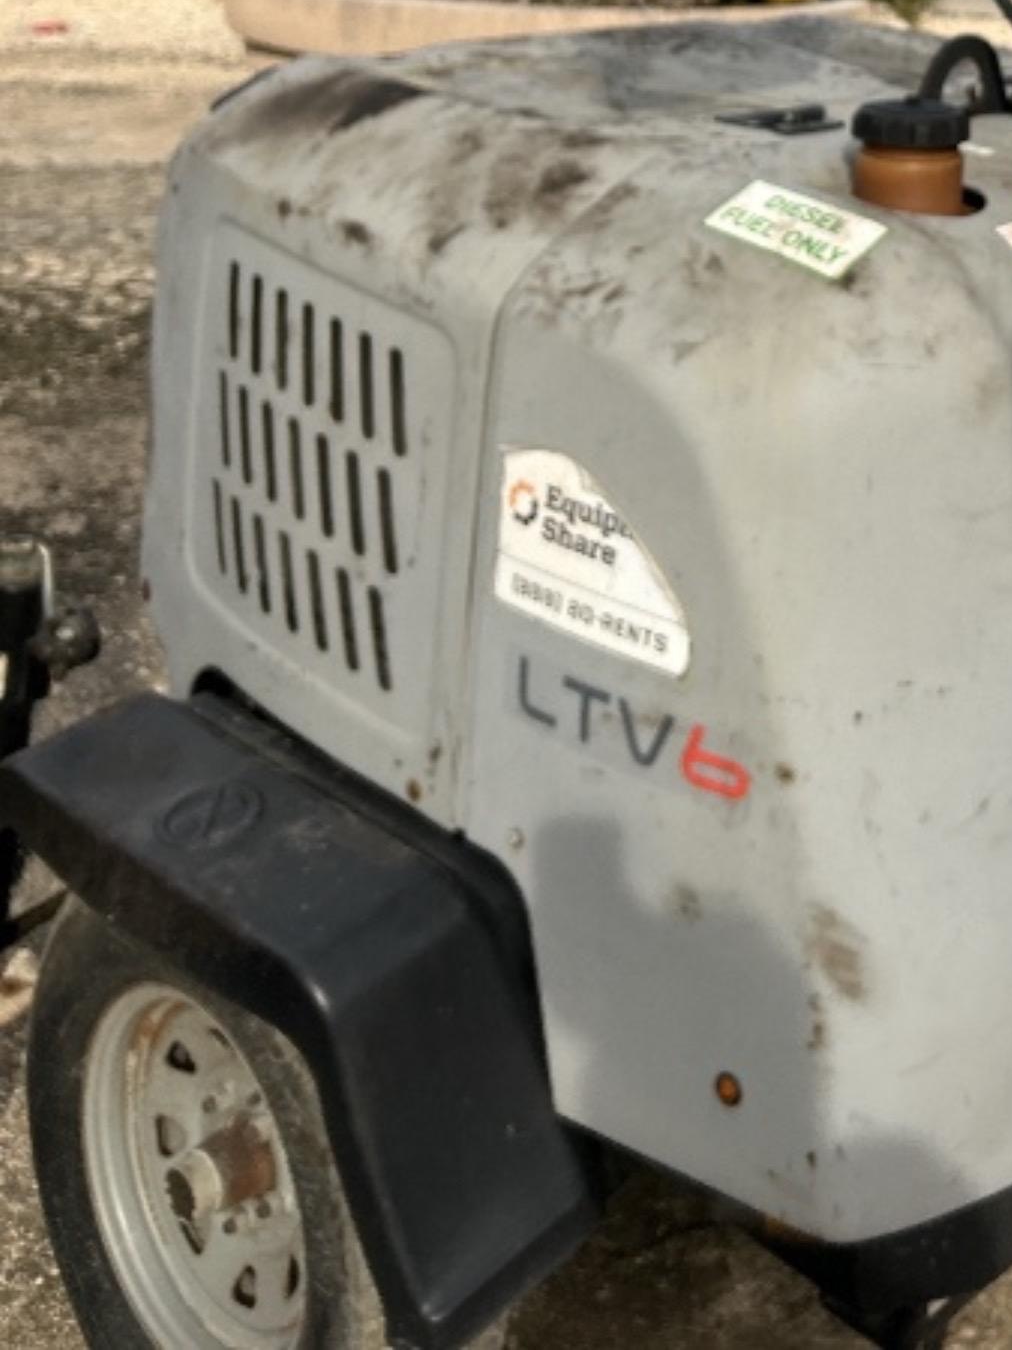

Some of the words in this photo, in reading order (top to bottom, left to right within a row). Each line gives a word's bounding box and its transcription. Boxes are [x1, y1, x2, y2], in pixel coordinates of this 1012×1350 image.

[719, 206, 777, 238] FUEL
[781, 230, 850, 262] ONLY
[764, 194, 845, 234] DIESEL
[541, 516, 617, 566] Share
[518, 656, 753, 803] LTV6
